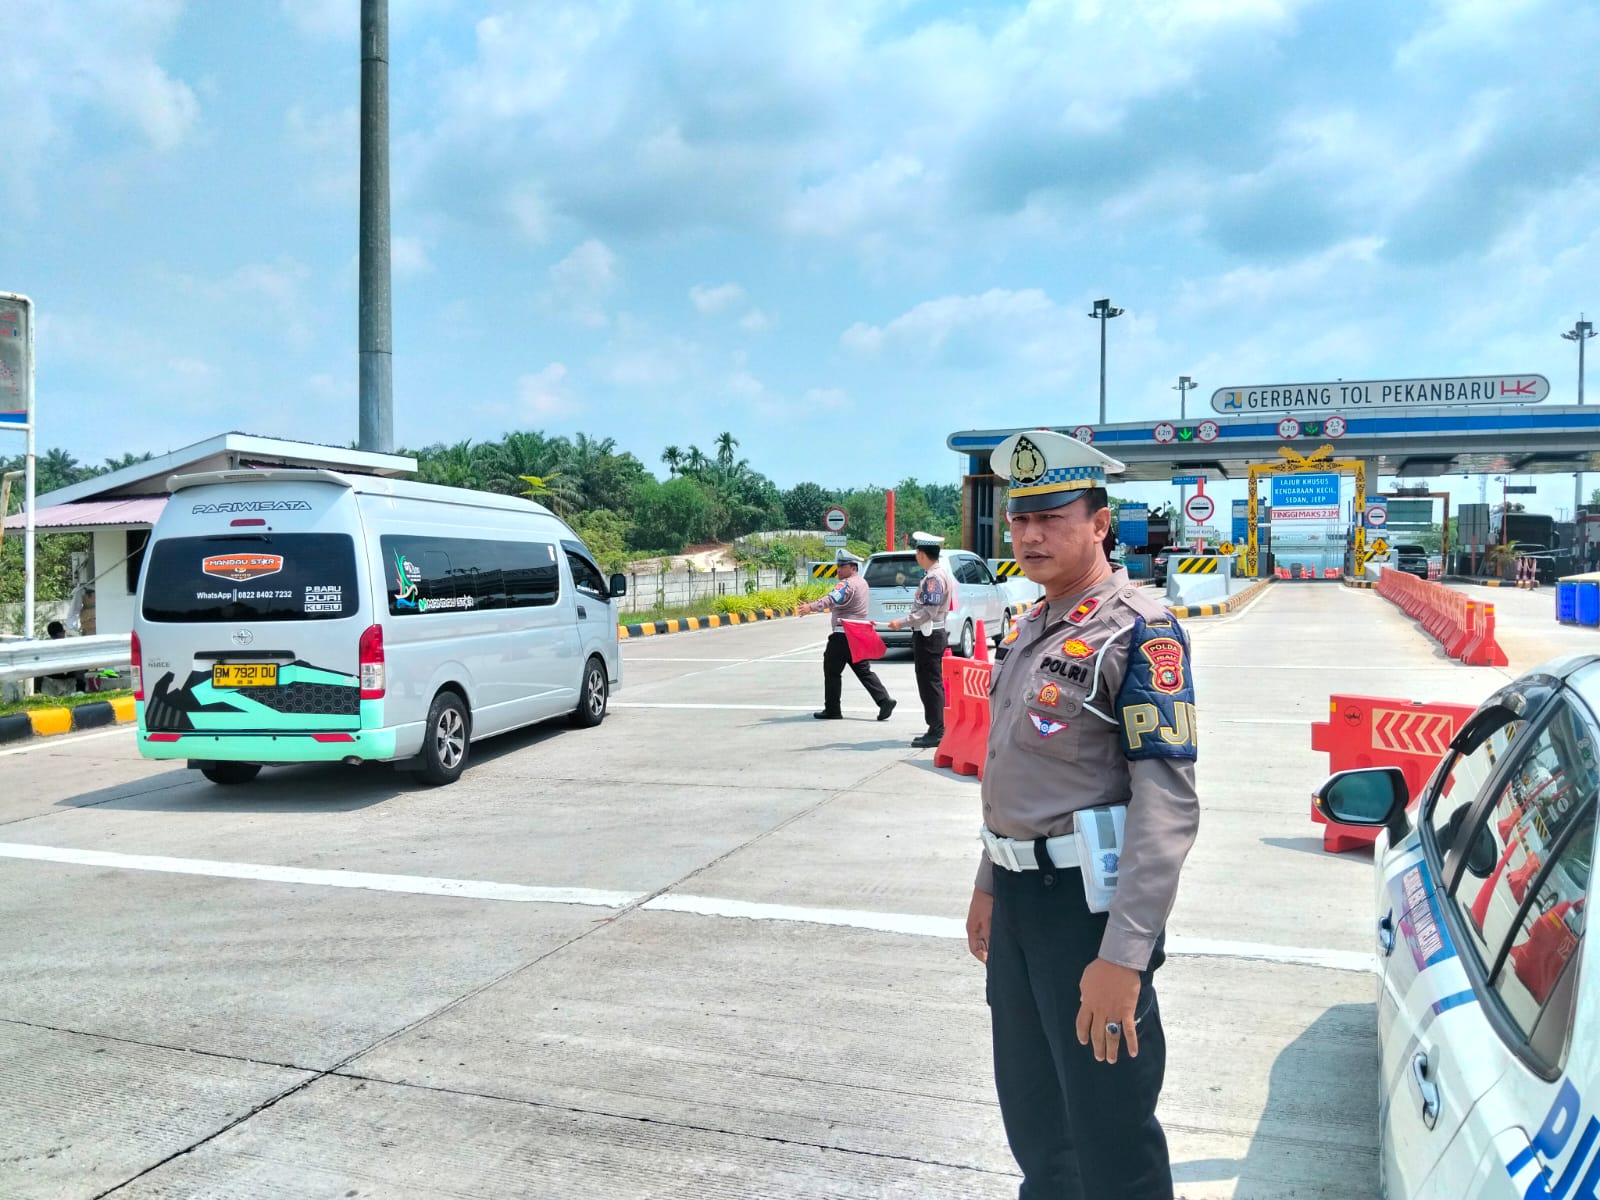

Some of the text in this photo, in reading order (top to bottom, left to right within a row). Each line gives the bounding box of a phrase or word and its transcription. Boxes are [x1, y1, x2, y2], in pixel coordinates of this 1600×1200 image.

[1248, 389, 1331, 409] GERBANG
[1341, 386, 1372, 405] TOL
[1382, 381, 1495, 403] PEKANBARU
[1280, 477, 1329, 486] LAJUR KHUSUS
[1274, 487, 1314, 495] KENDARAAN
[192, 500, 312, 514] PARIWISATA
[1272, 511, 1298, 519] TINGGI
[1298, 510, 1321, 518] MAKS
[197, 590, 293, 600] WhatsApp 0822 8402 7232
[1149, 643, 1178, 652] POLDA
[215, 667, 230, 678] BM
[234, 667, 258, 679] 7921
[1040, 657, 1088, 683] POLRI
